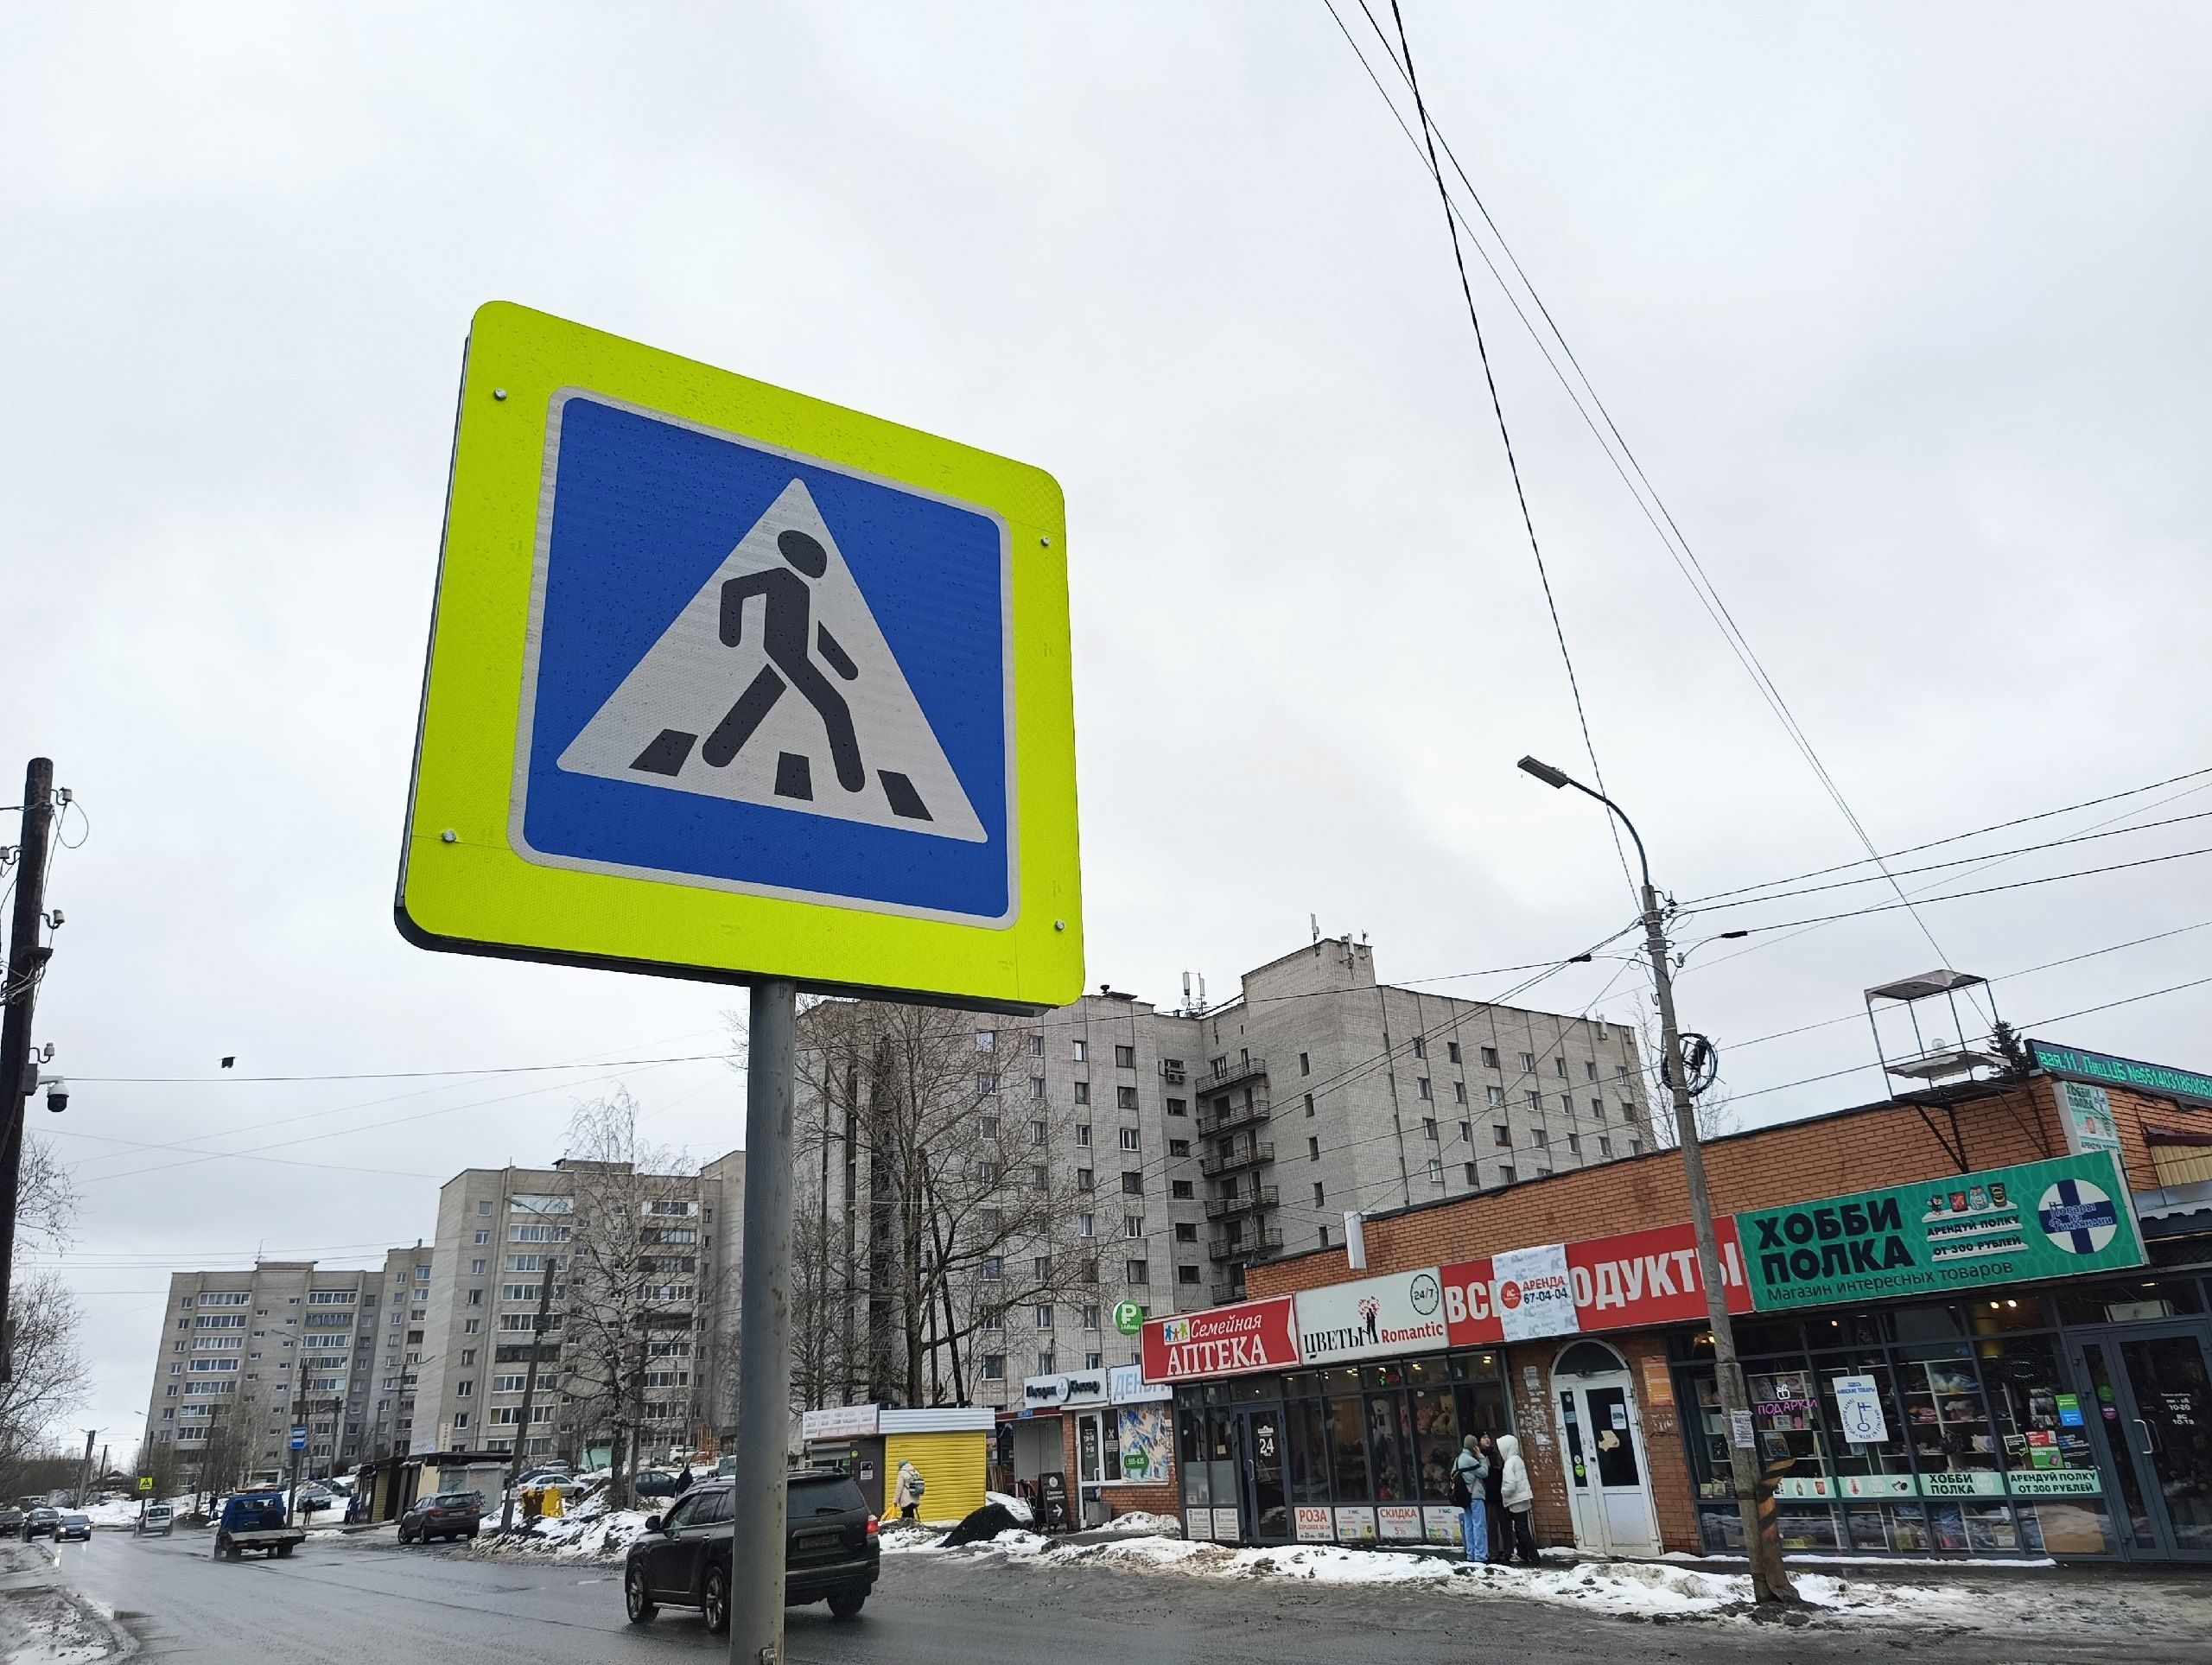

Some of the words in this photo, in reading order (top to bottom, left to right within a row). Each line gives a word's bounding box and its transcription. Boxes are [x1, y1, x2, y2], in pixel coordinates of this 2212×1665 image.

[1753, 1198, 1903, 1250] ХОББИ
[1927, 1218, 1977, 1236] АРЕНДУЙ
[1980, 1215, 2020, 1229] ПОЛКУ
[1934, 1246, 1948, 1256] ОТ
[1977, 1235, 2021, 1250] РУБЛЕЙ
[1761, 1236, 1916, 1285] ПОЛКА
[1522, 1275, 1566, 1292] АРЕНДА
[1569, 1242, 1743, 1311] ОДУКТЫ
[1767, 1284, 1833, 1301] Магазин
[1837, 1271, 1936, 1292] интересных
[1938, 1261, 2014, 1281] товаров
[1414, 1287, 1433, 1300] 24/7
[1523, 1287, 1568, 1304] 67-04-04
[1191, 1314, 1262, 1338] Семейная
[1382, 1321, 1443, 1343] Romantic
[1303, 1326, 1365, 1360] ЦВЕТЫ
[1166, 1334, 1268, 1376] АПТЕКА
[1758, 1400, 1818, 1415] ПОДАРКИ
[1259, 1438, 1274, 1453] 24
[1929, 1473, 1973, 1484] ХОББИ
[2011, 1472, 2057, 1484] АРЕНДУЙ
[2059, 1472, 2096, 1482] ПОЛКУ
[1931, 1484, 1975, 1496] ПОЛКА
[2053, 1482, 2094, 1492] РУБЛЕЙ
[1299, 1509, 1327, 1522] РОЗА
[1380, 1508, 1417, 1519] СКИДКА
